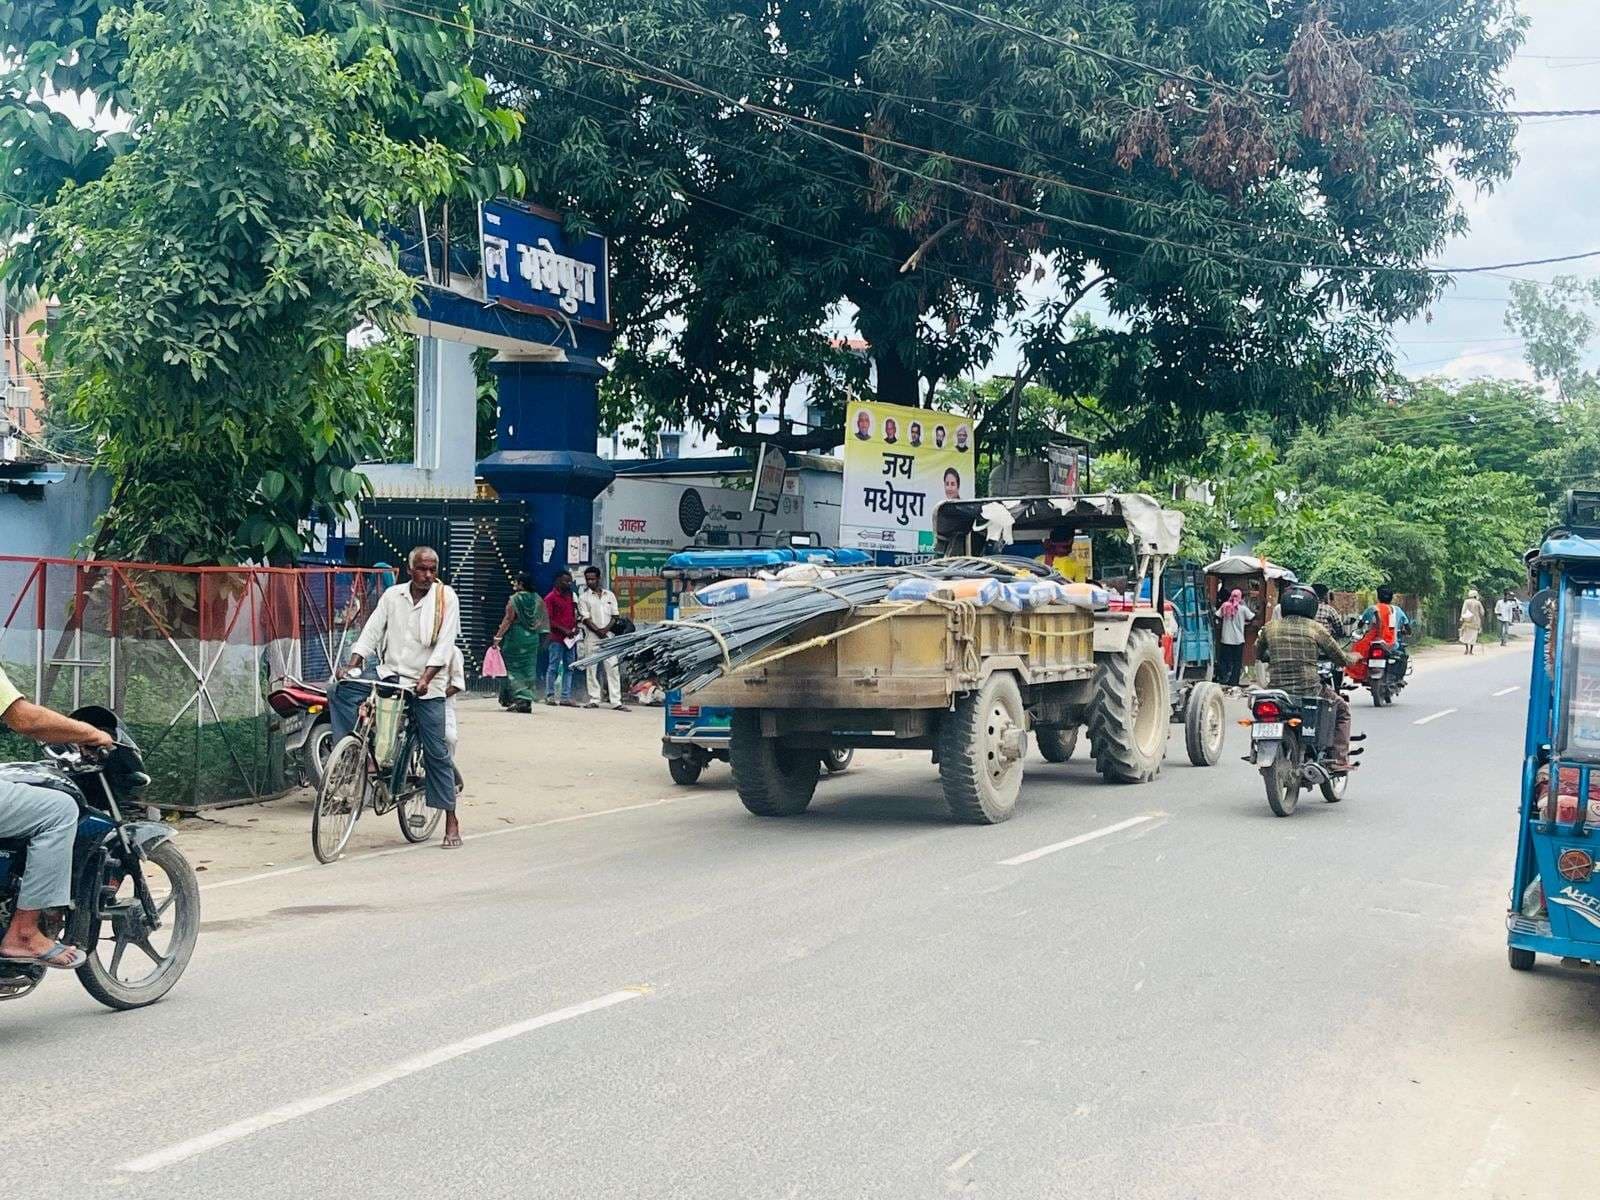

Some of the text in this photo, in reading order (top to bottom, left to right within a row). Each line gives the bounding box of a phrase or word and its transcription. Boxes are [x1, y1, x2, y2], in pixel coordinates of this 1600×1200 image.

[517, 238, 596, 314] मधेपुरा
[882, 452, 914, 479] जय
[863, 481, 926, 525] मधेपुरा
[618, 519, 647, 533] आहार
